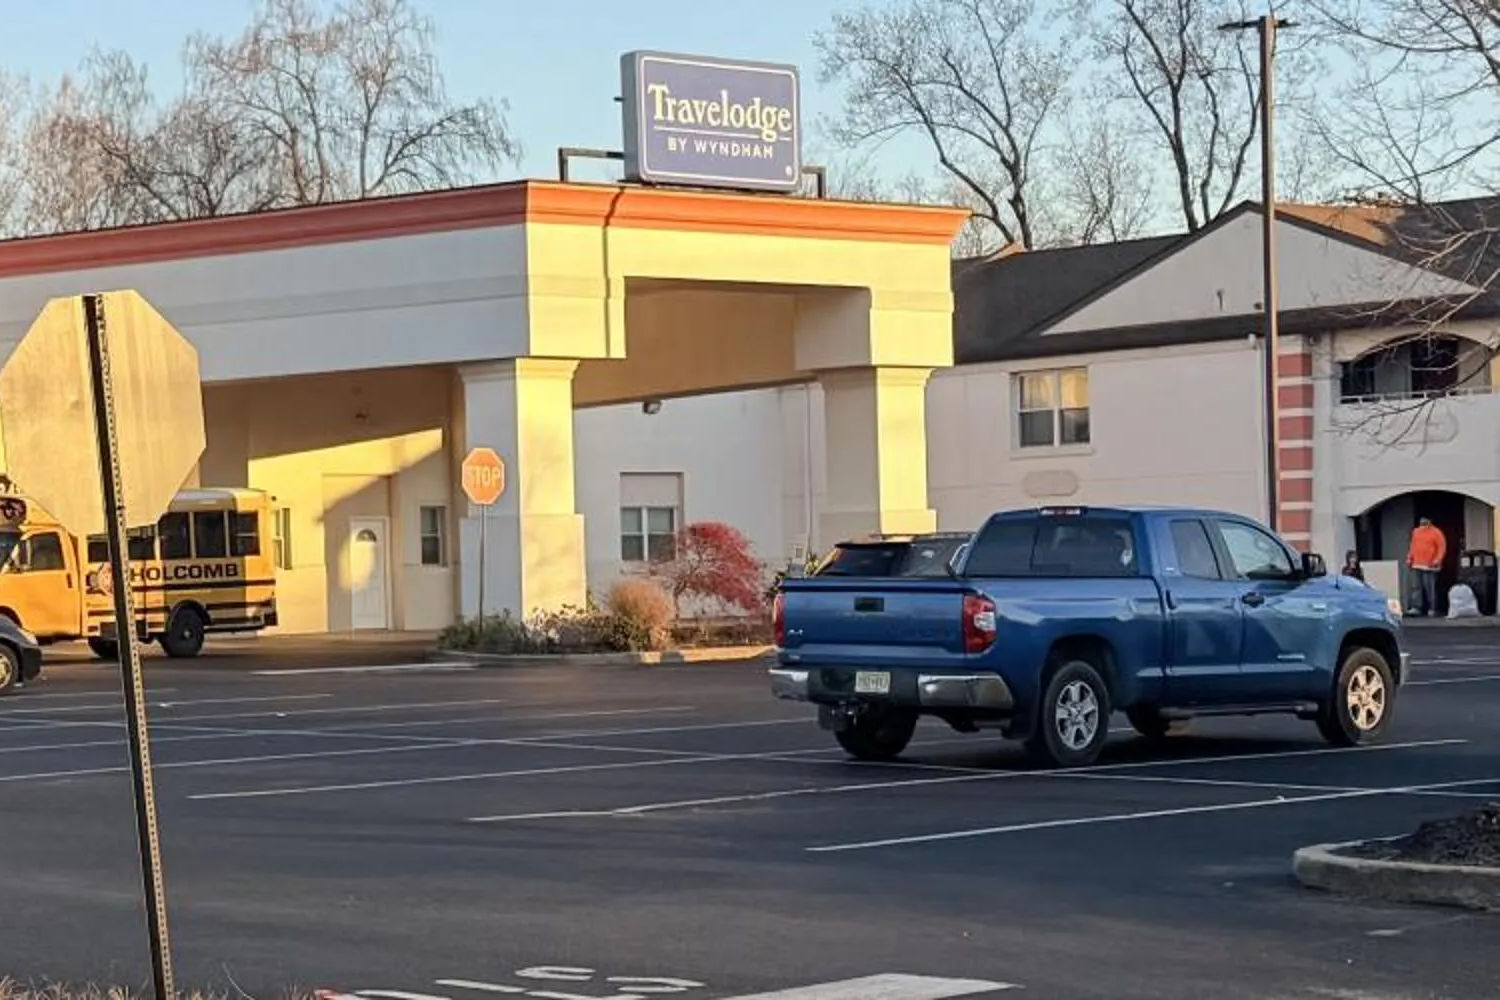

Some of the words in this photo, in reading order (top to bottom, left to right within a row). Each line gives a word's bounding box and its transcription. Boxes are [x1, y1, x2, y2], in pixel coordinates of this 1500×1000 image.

[647, 83, 792, 142] Travelodge
[668, 137, 687, 153] BY
[694, 139, 773, 159] WYNDHAM
[465, 465, 501, 488] STOP
[130, 563, 238, 581] HOLCOMB
